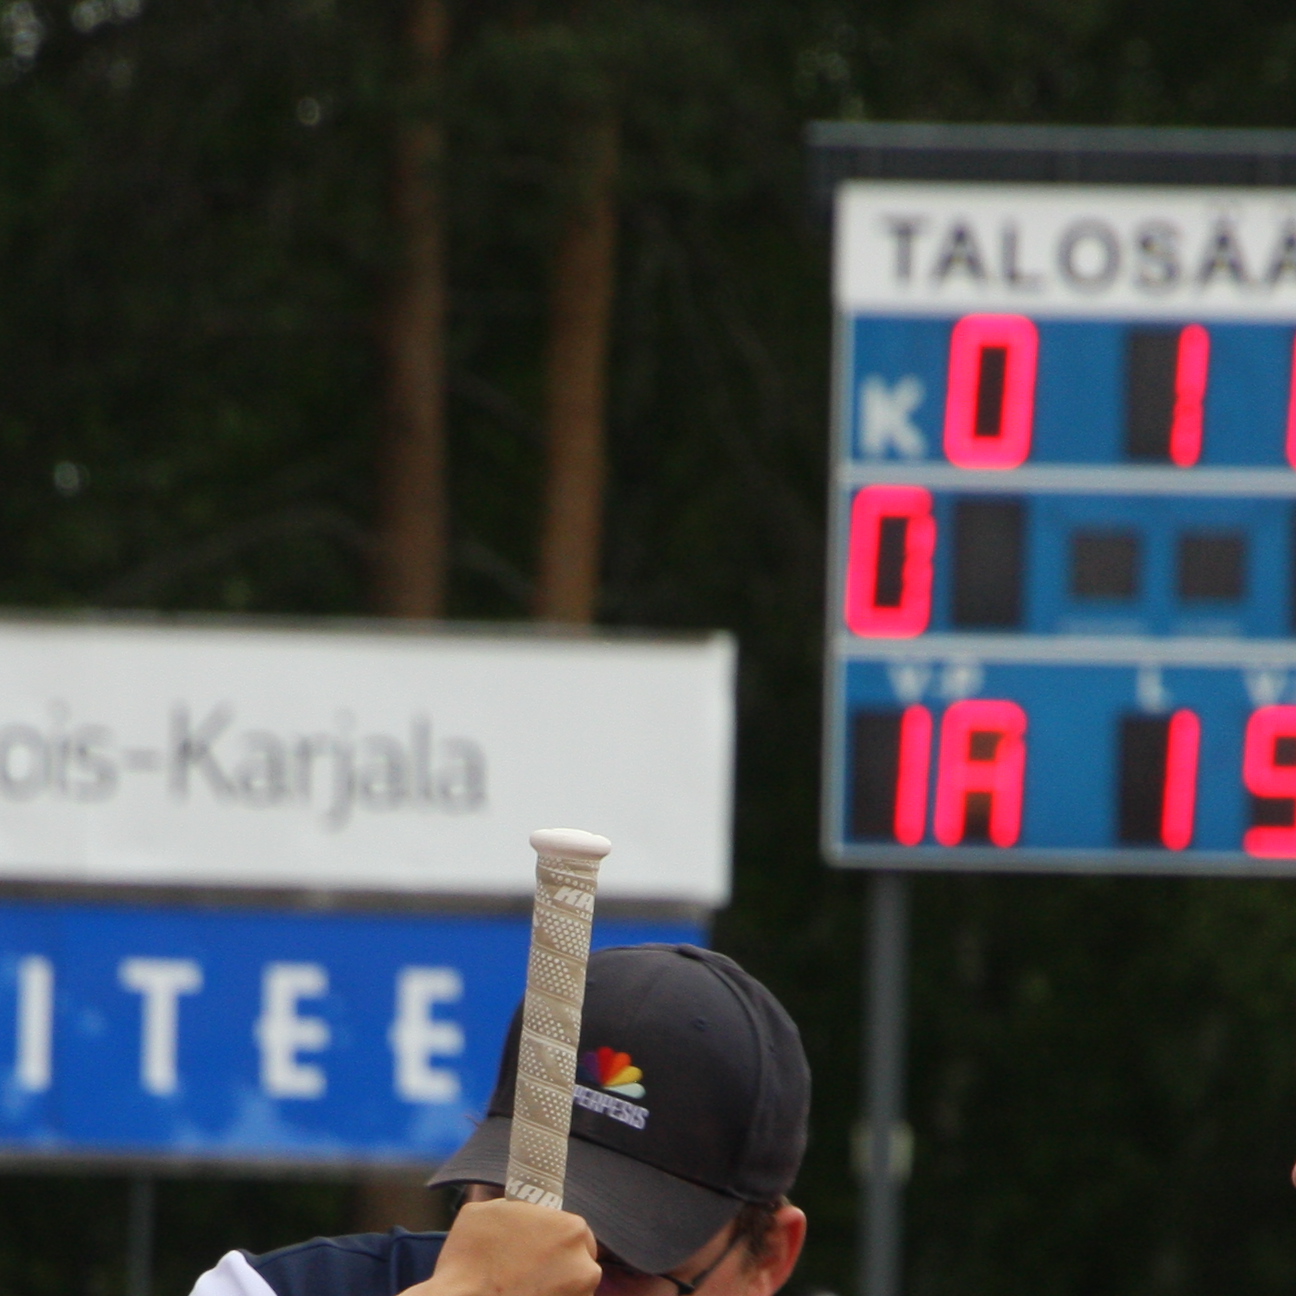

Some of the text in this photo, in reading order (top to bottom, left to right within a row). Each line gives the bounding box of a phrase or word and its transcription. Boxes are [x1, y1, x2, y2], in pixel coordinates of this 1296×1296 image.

[858, 380, 923, 459] K
[942, 314, 1040, 470] 0
[1168, 324, 1210, 468] 1
